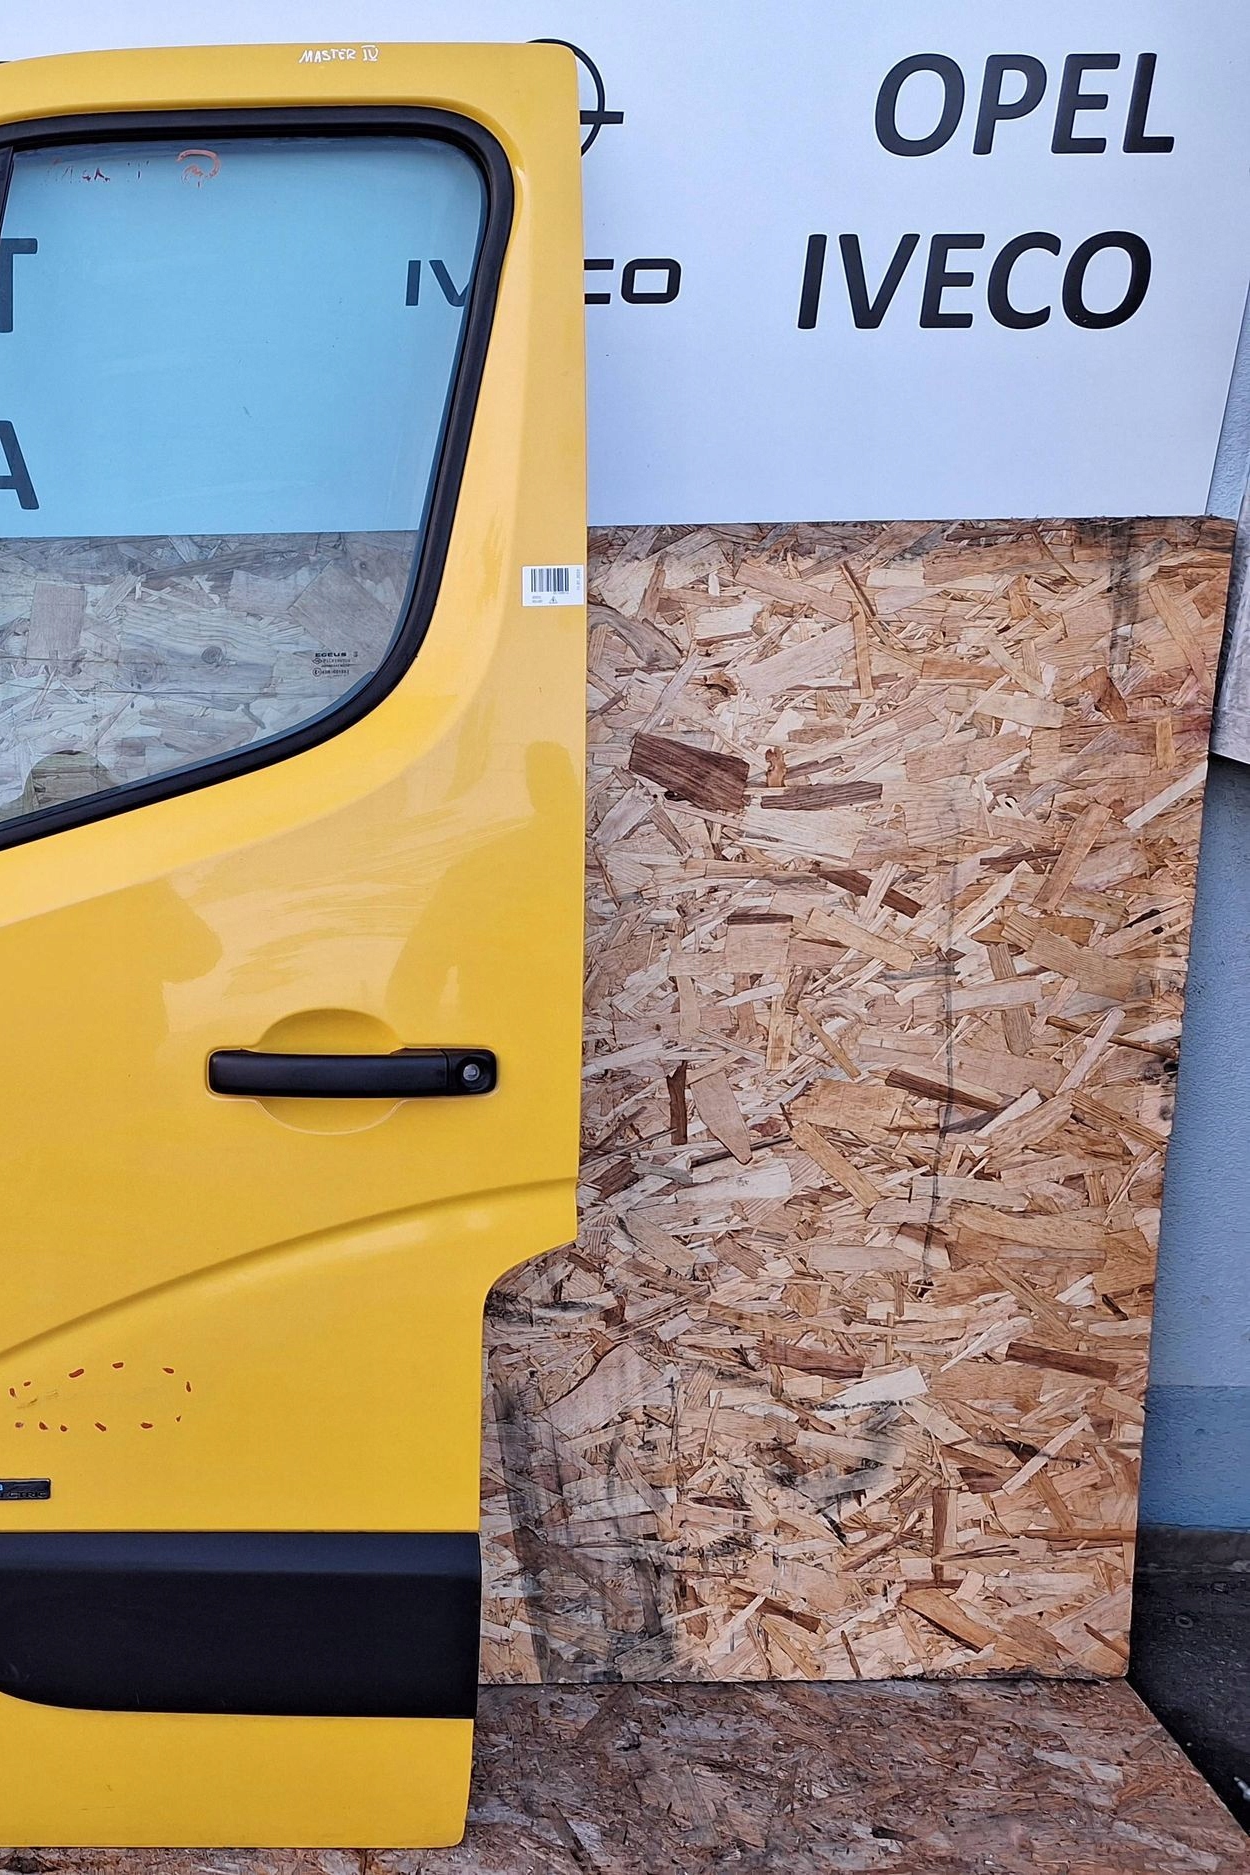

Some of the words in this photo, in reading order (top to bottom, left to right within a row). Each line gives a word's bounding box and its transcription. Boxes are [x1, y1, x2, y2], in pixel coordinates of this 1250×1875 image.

[298, 47, 357, 64] MASTER
[874, 53, 1174, 157] OPEL
[405, 258, 682, 307] IVO
[798, 230, 1152, 330] IVECO
